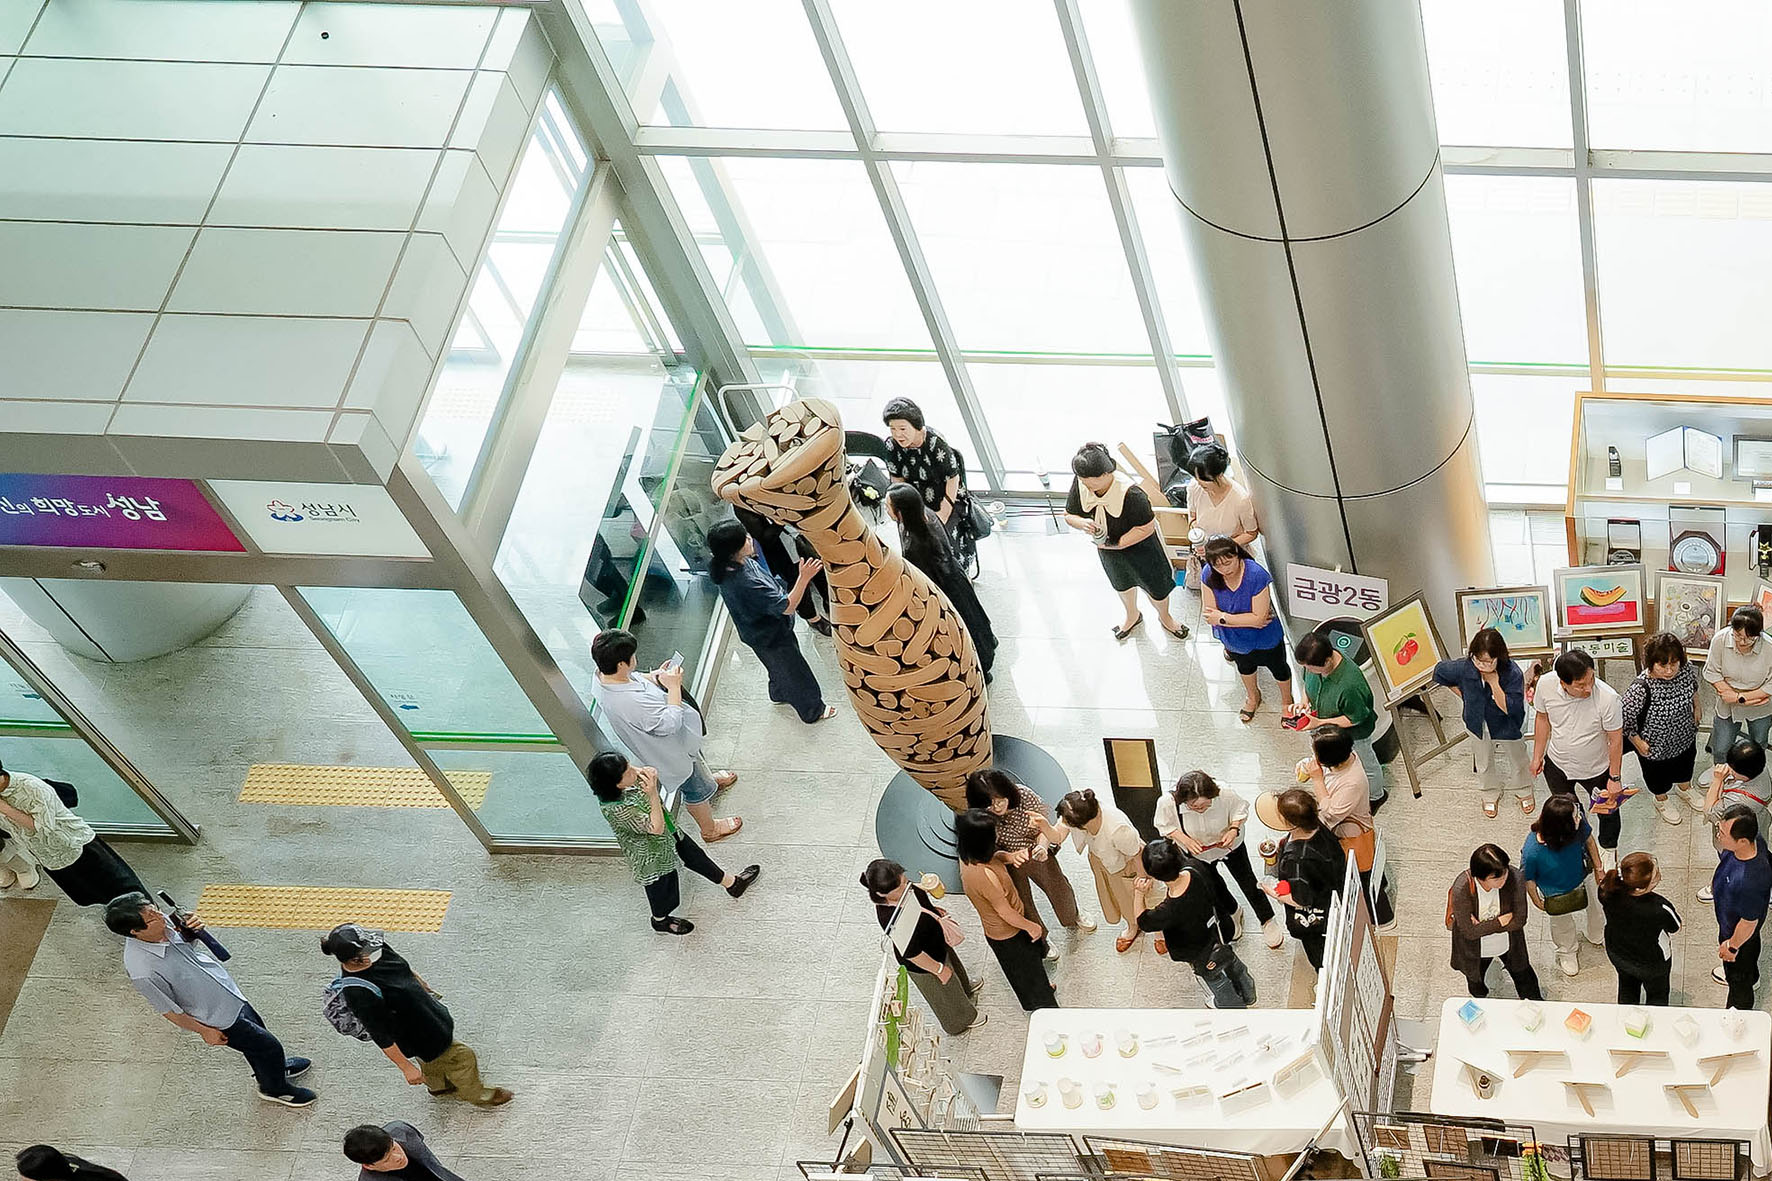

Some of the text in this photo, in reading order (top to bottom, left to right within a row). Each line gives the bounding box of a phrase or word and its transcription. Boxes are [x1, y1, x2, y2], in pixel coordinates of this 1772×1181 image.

[106, 493, 167, 520] 성남
[301, 503, 357, 517] 성남시
[1294, 577, 1382, 611] 금광2동
